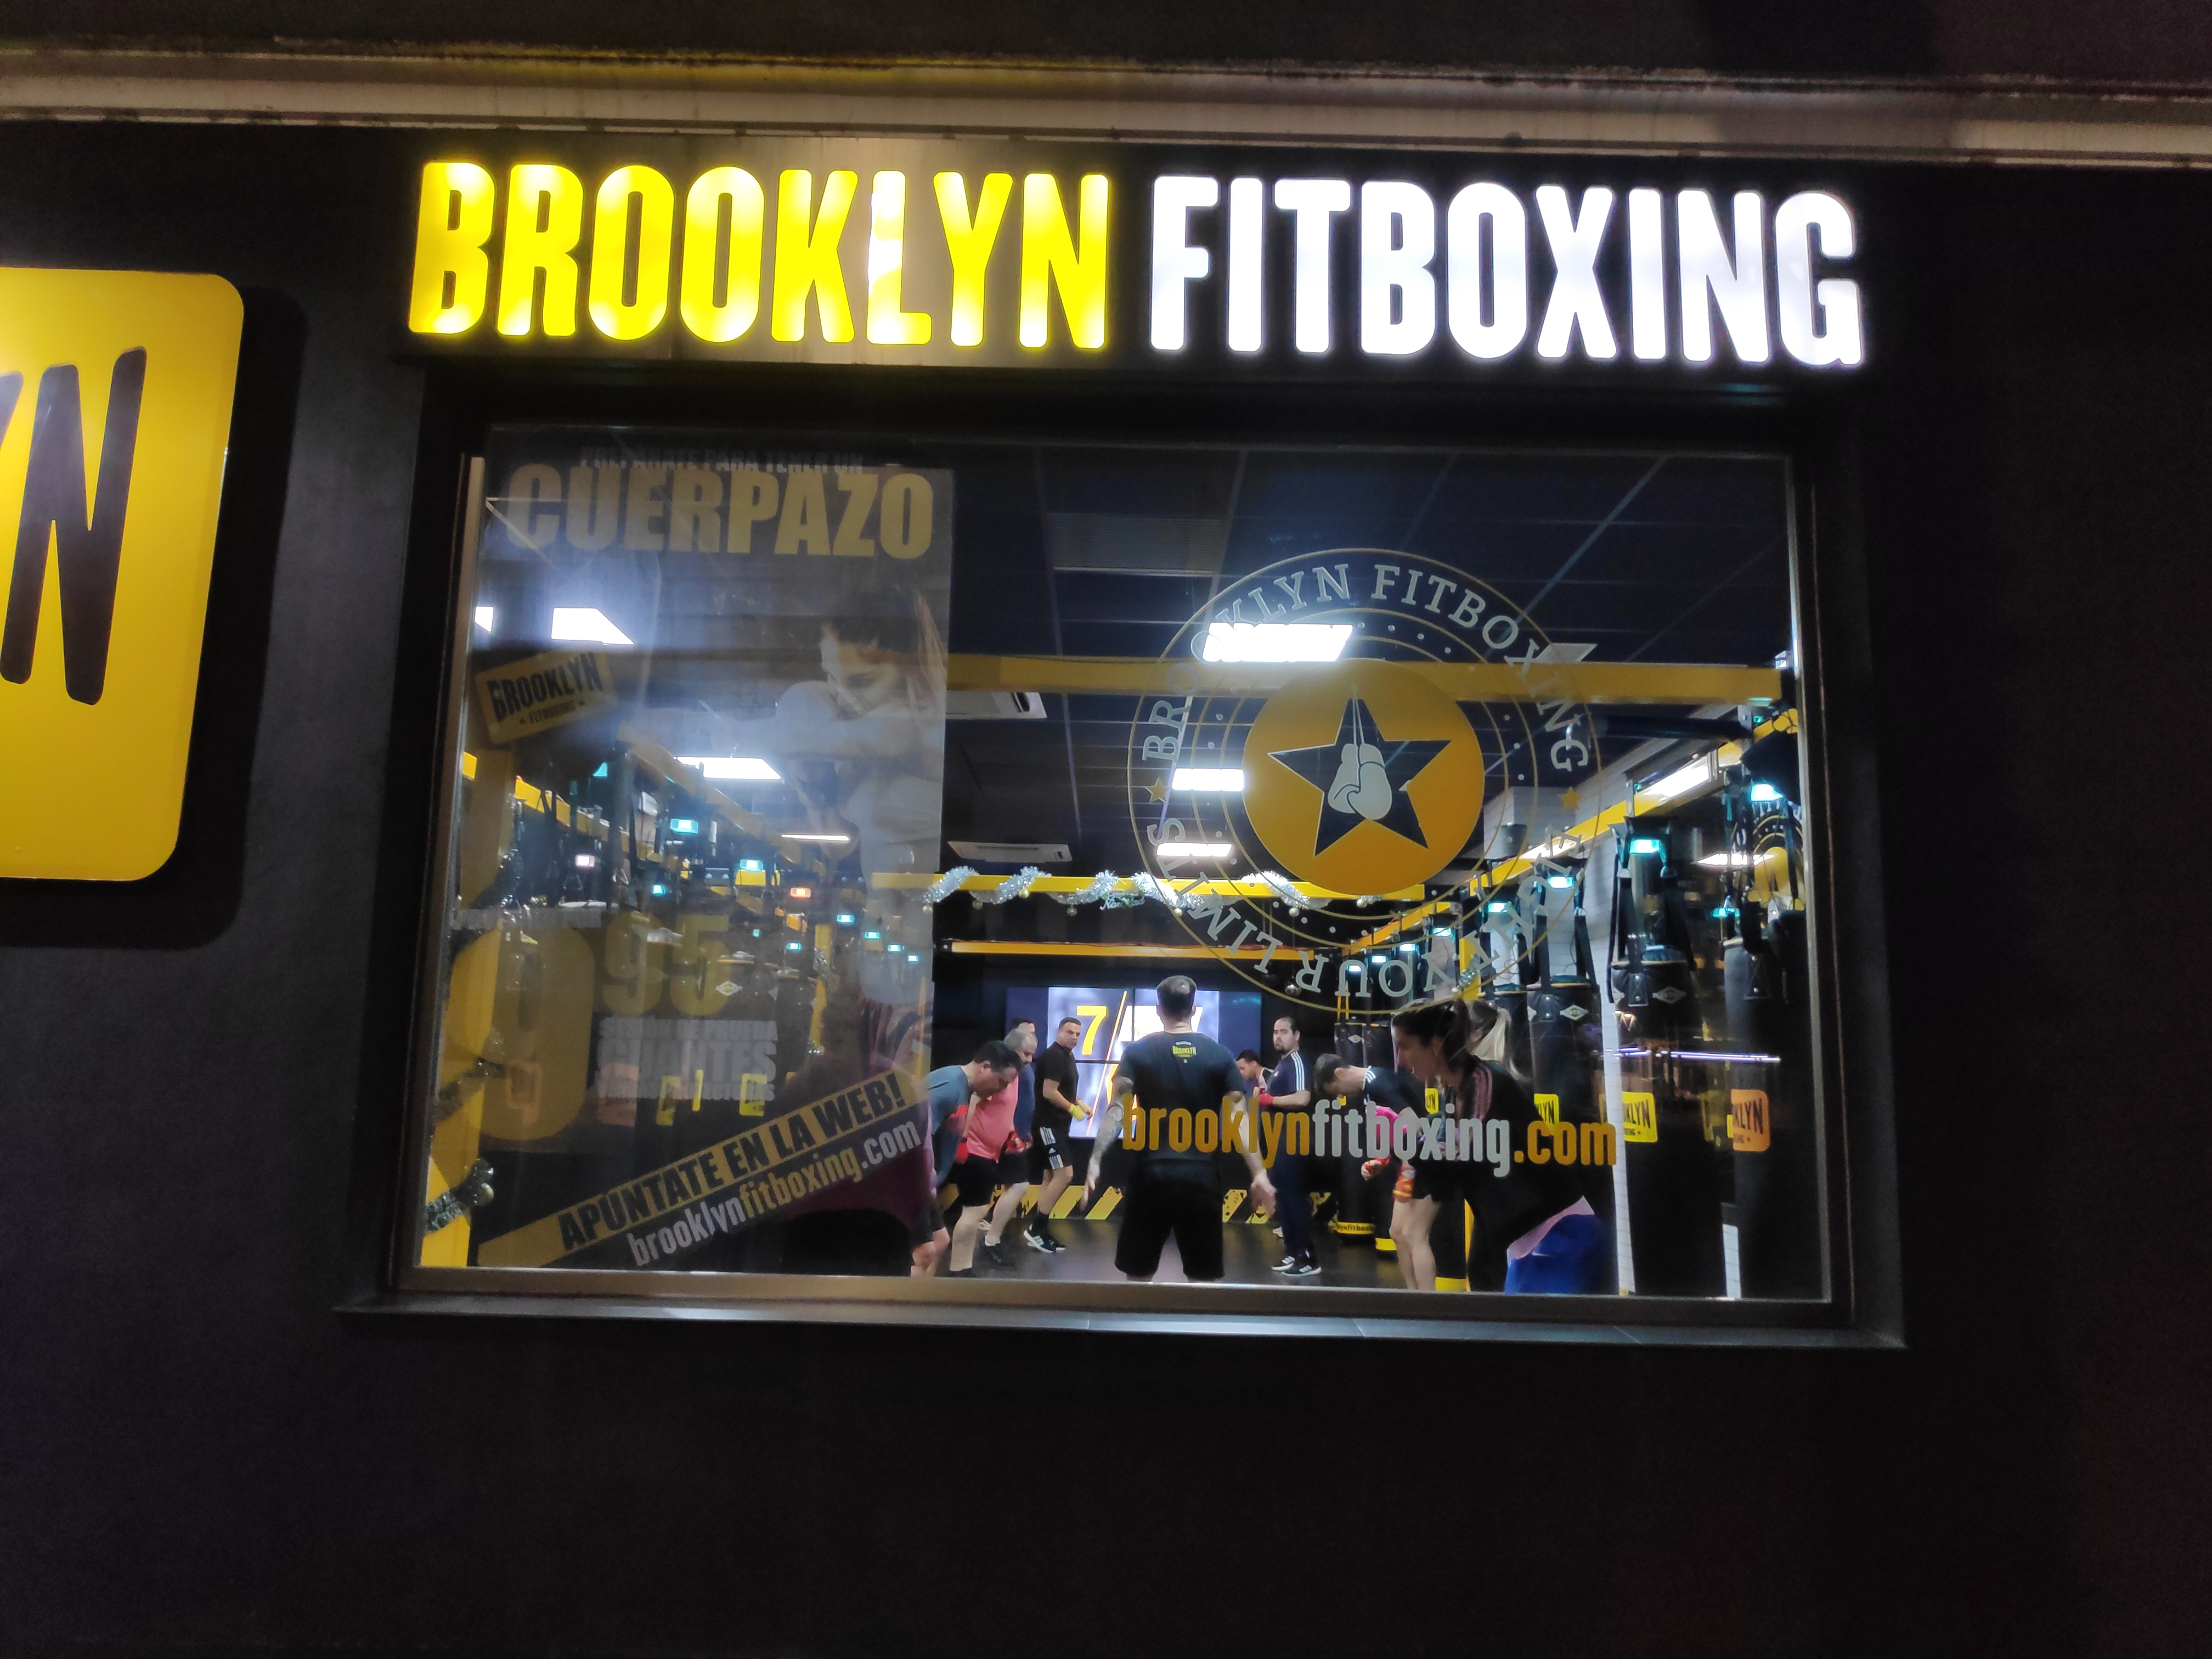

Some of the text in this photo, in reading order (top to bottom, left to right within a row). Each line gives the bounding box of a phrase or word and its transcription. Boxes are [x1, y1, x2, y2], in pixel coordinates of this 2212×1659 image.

[409, 162, 1863, 365] BROOKLYN FITBOXING
[507, 464, 934, 560] CUERPAZO
[487, 652, 603, 722] BROOKLYN
[1370, 563, 1589, 772] FITBOXING
[1147, 819, 1582, 998] FIGHT YOUR LIMITS
[1077, 1006, 1107, 1055] 7
[558, 1152, 724, 1251] APUNTATE
[721, 1132, 770, 1179] EN
[769, 1114, 816, 1159] LA
[812, 1073, 906, 1139] WEB!
[628, 1121, 922, 1266] brooklynfitboxing.com
[1122, 1092, 1617, 1177] brooklynfitboxing.com
